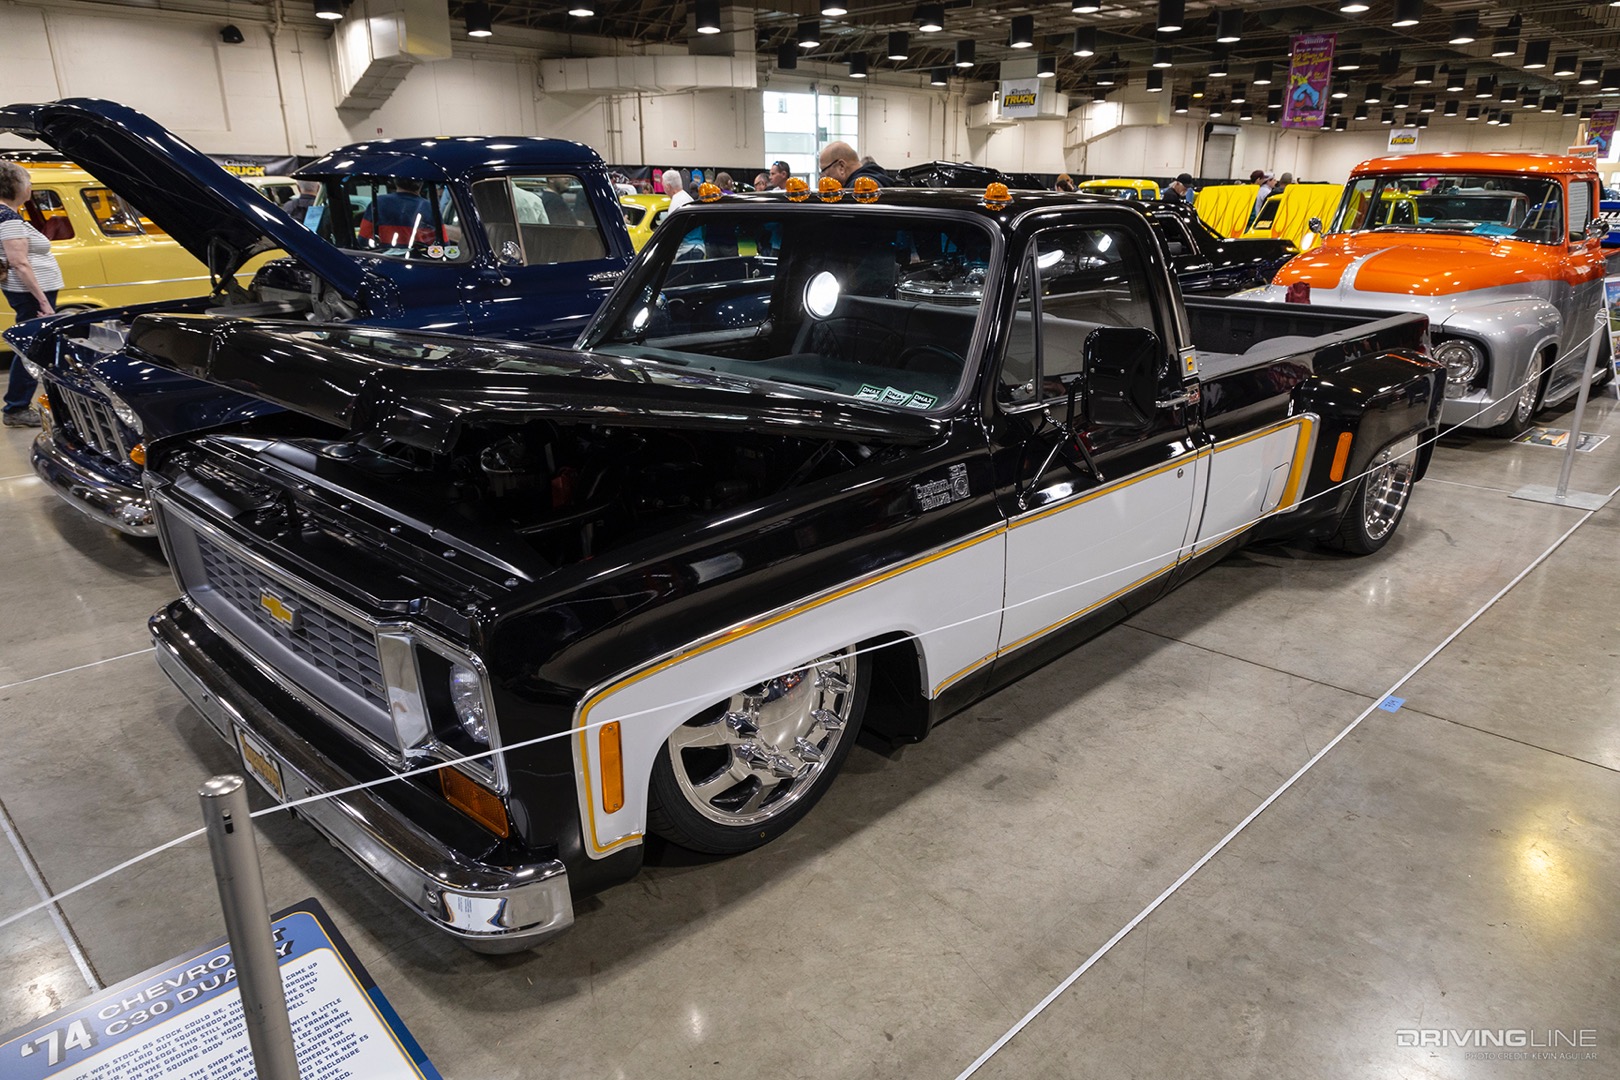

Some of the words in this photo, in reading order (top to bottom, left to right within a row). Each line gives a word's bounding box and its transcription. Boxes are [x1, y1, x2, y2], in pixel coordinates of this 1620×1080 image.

[1004, 93, 1037, 107] TRUCK
[887, 390, 906, 400] DMAX
[914, 394, 934, 405] DMAX
[97, 928, 281, 1020] CHEVROT
[91, 1063, 110, 1075] WAS
[113, 1049, 139, 1064] STOCK
[156, 1028, 182, 1043] STOCK
[185, 1014, 210, 1029] COULD
[213, 1008, 226, 1016] BE.
[286, 968, 306, 981] CAME
[308, 962, 318, 970] UP
[104, 1001, 168, 1037] C30
[107, 1061, 130, 1076] FIRST
[134, 1051, 153, 1062] LAID
[156, 1041, 171, 1052] OUT
[175, 1014, 227, 1042] SQUAREBODY
[285, 971, 317, 988] AROUND.
[127, 1047, 176, 1074] KNOWLEDGE
[180, 1037, 198, 1048] THIS
[200, 1026, 220, 1038] STILL
[223, 1014, 246, 1027] REMA
[299, 978, 318, 989] ONLY
[308, 1028, 333, 1043] TURBO
[334, 1017, 353, 1029] WITH
[314, 1011, 349, 1032] DURAMAX
[145, 1063, 160, 1073] THE
[164, 1045, 201, 1065] GROUND.
[203, 1035, 218, 1045] THE
[221, 1023, 243, 1036] HOOD
[189, 1068, 205, 1078] THE
[207, 1053, 234, 1069] SHAPE
[236, 1046, 248, 1054] WE
[290, 1015, 309, 1027] WITH
[319, 998, 341, 1012] LITTLE
[211, 1065, 228, 1076] HER
[304, 1013, 329, 1028] FRAME
[297, 1040, 327, 1058] DAKOTA
[324, 1050, 339, 1060] THE
[341, 1040, 357, 1052] NEW
[332, 1033, 356, 1047] TRUCK
[166, 1053, 199, 1072] SQUARE
[202, 1041, 223, 1054] BODY
[317, 1048, 360, 1074] ENCLOSURE
